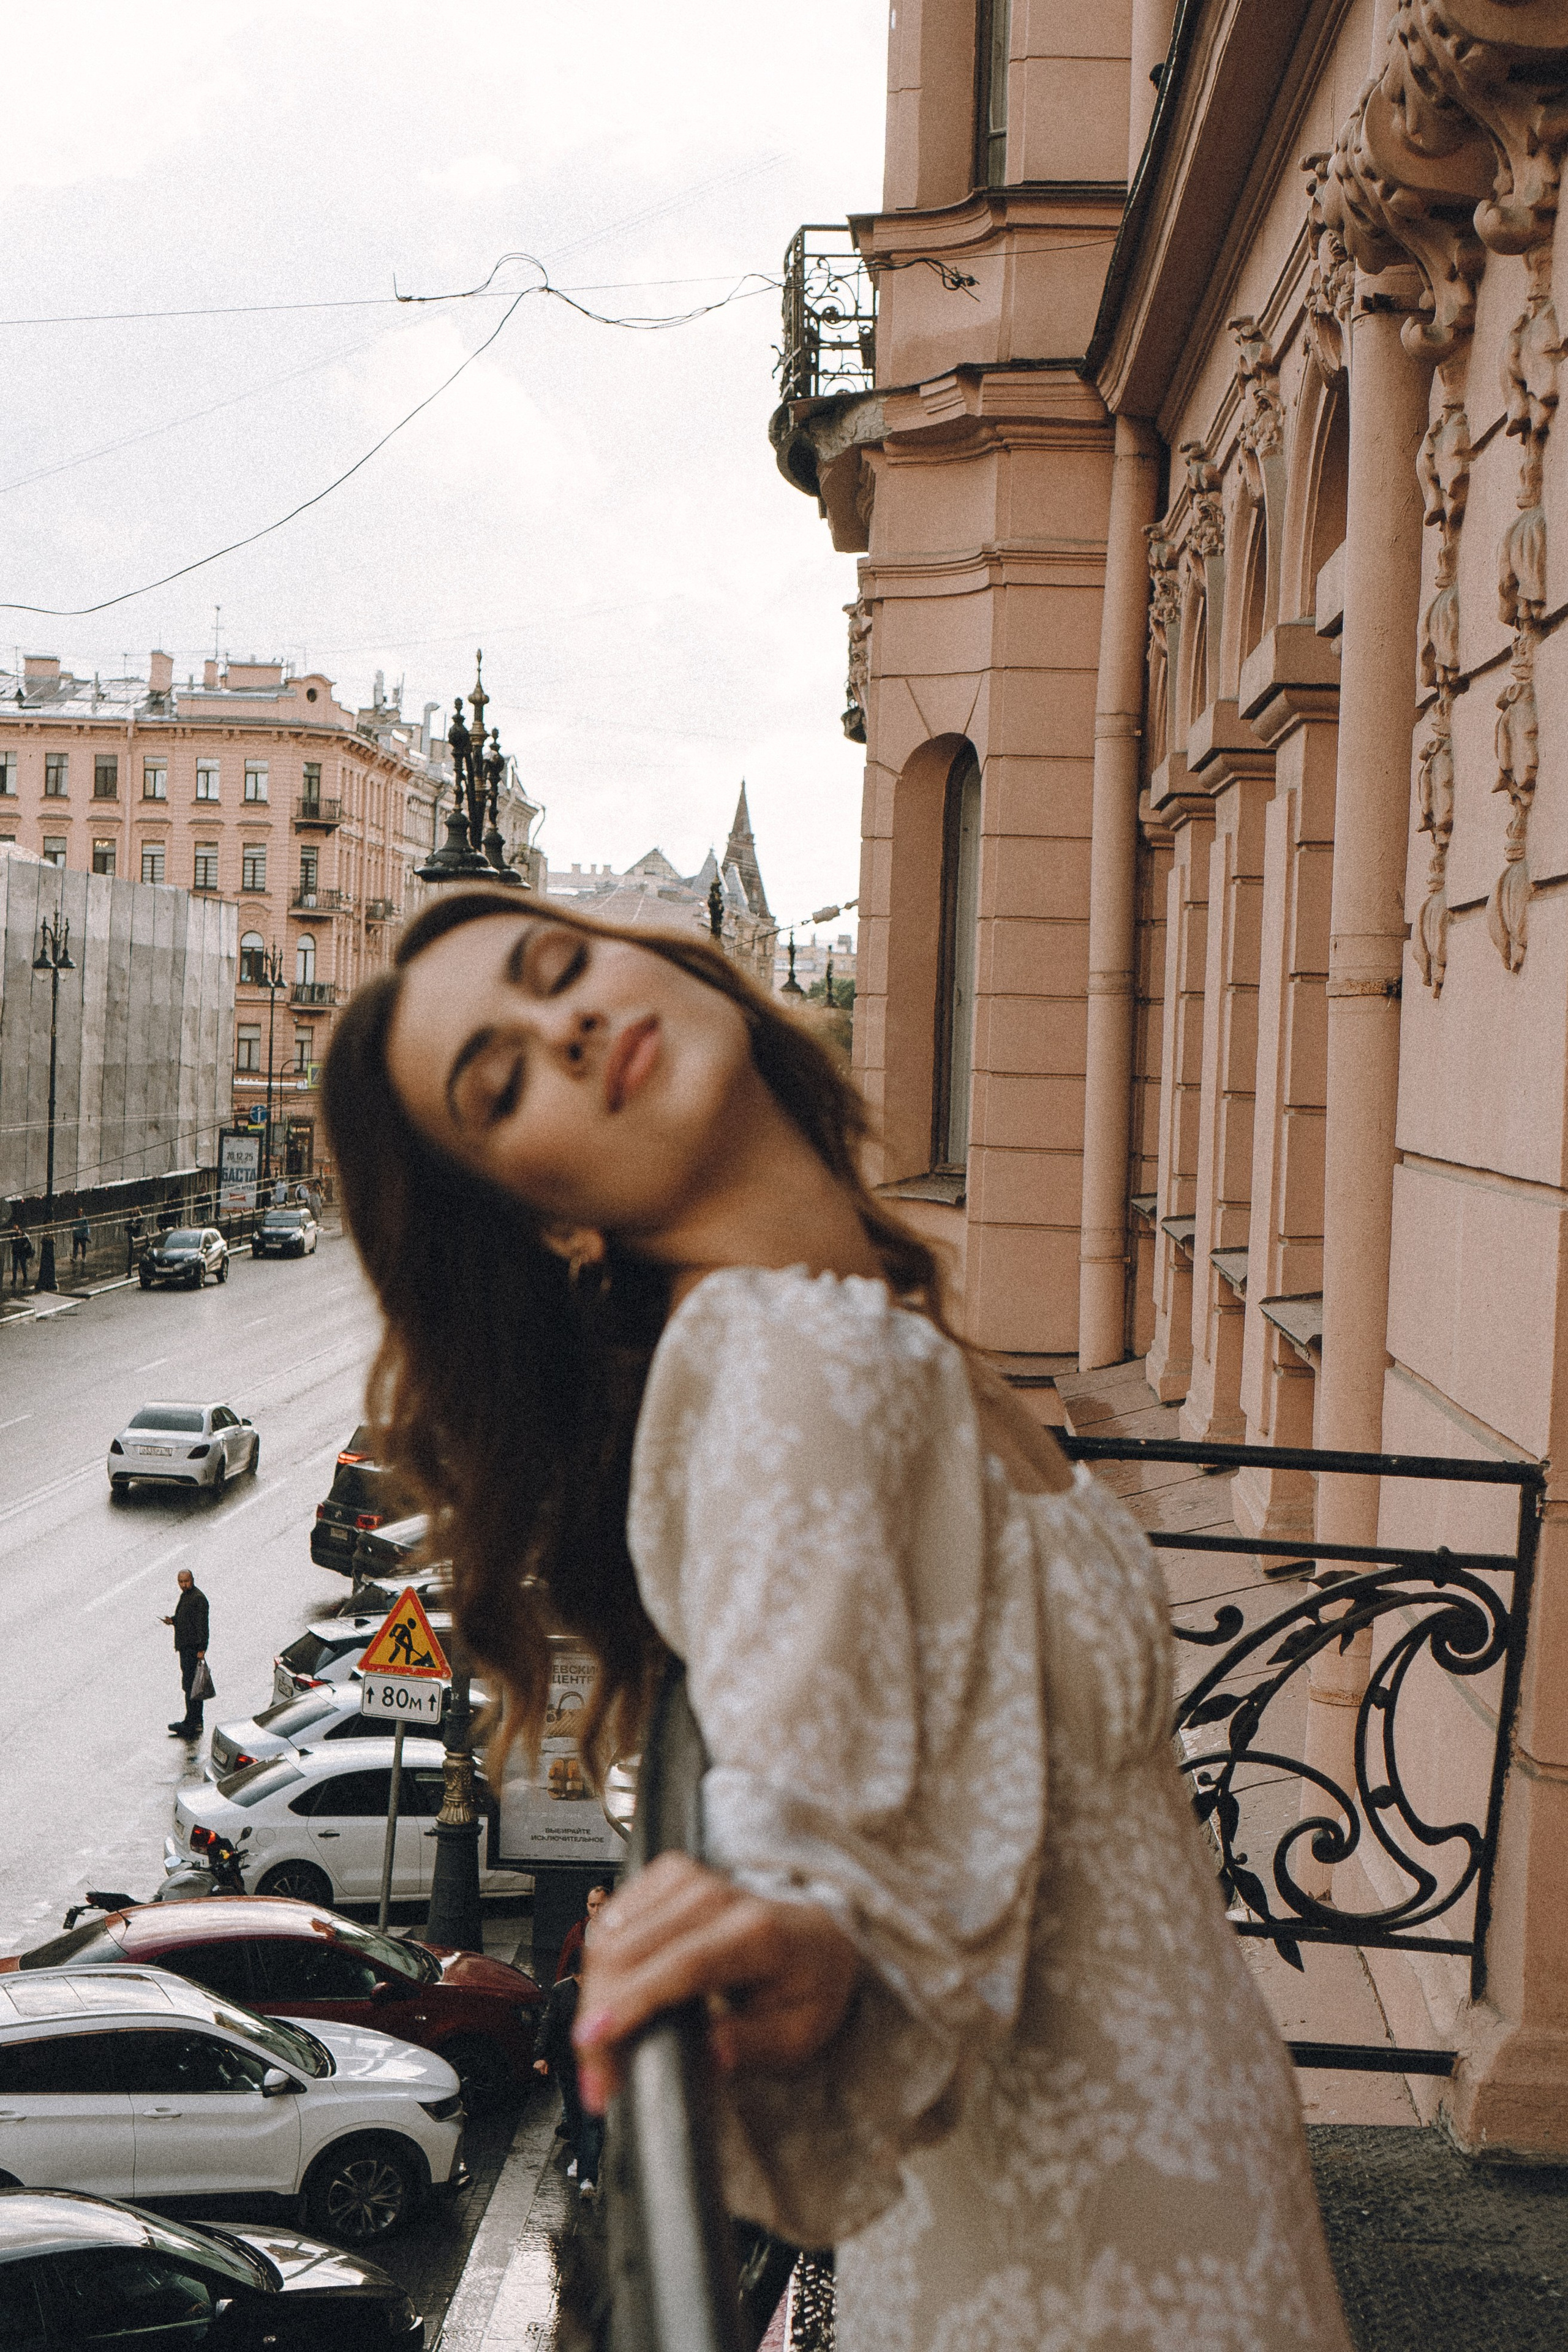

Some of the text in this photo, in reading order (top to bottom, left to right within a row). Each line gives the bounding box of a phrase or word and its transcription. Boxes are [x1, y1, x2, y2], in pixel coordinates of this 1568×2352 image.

[222, 1167, 256, 1182] БАСТА
[552, 1664, 597, 1675] ЕВСКИ
[552, 1675, 594, 1684] ЦЕНТР
[530, 1834, 605, 1843] ИСКЛЮЧИТЕЛЬНОЕ
